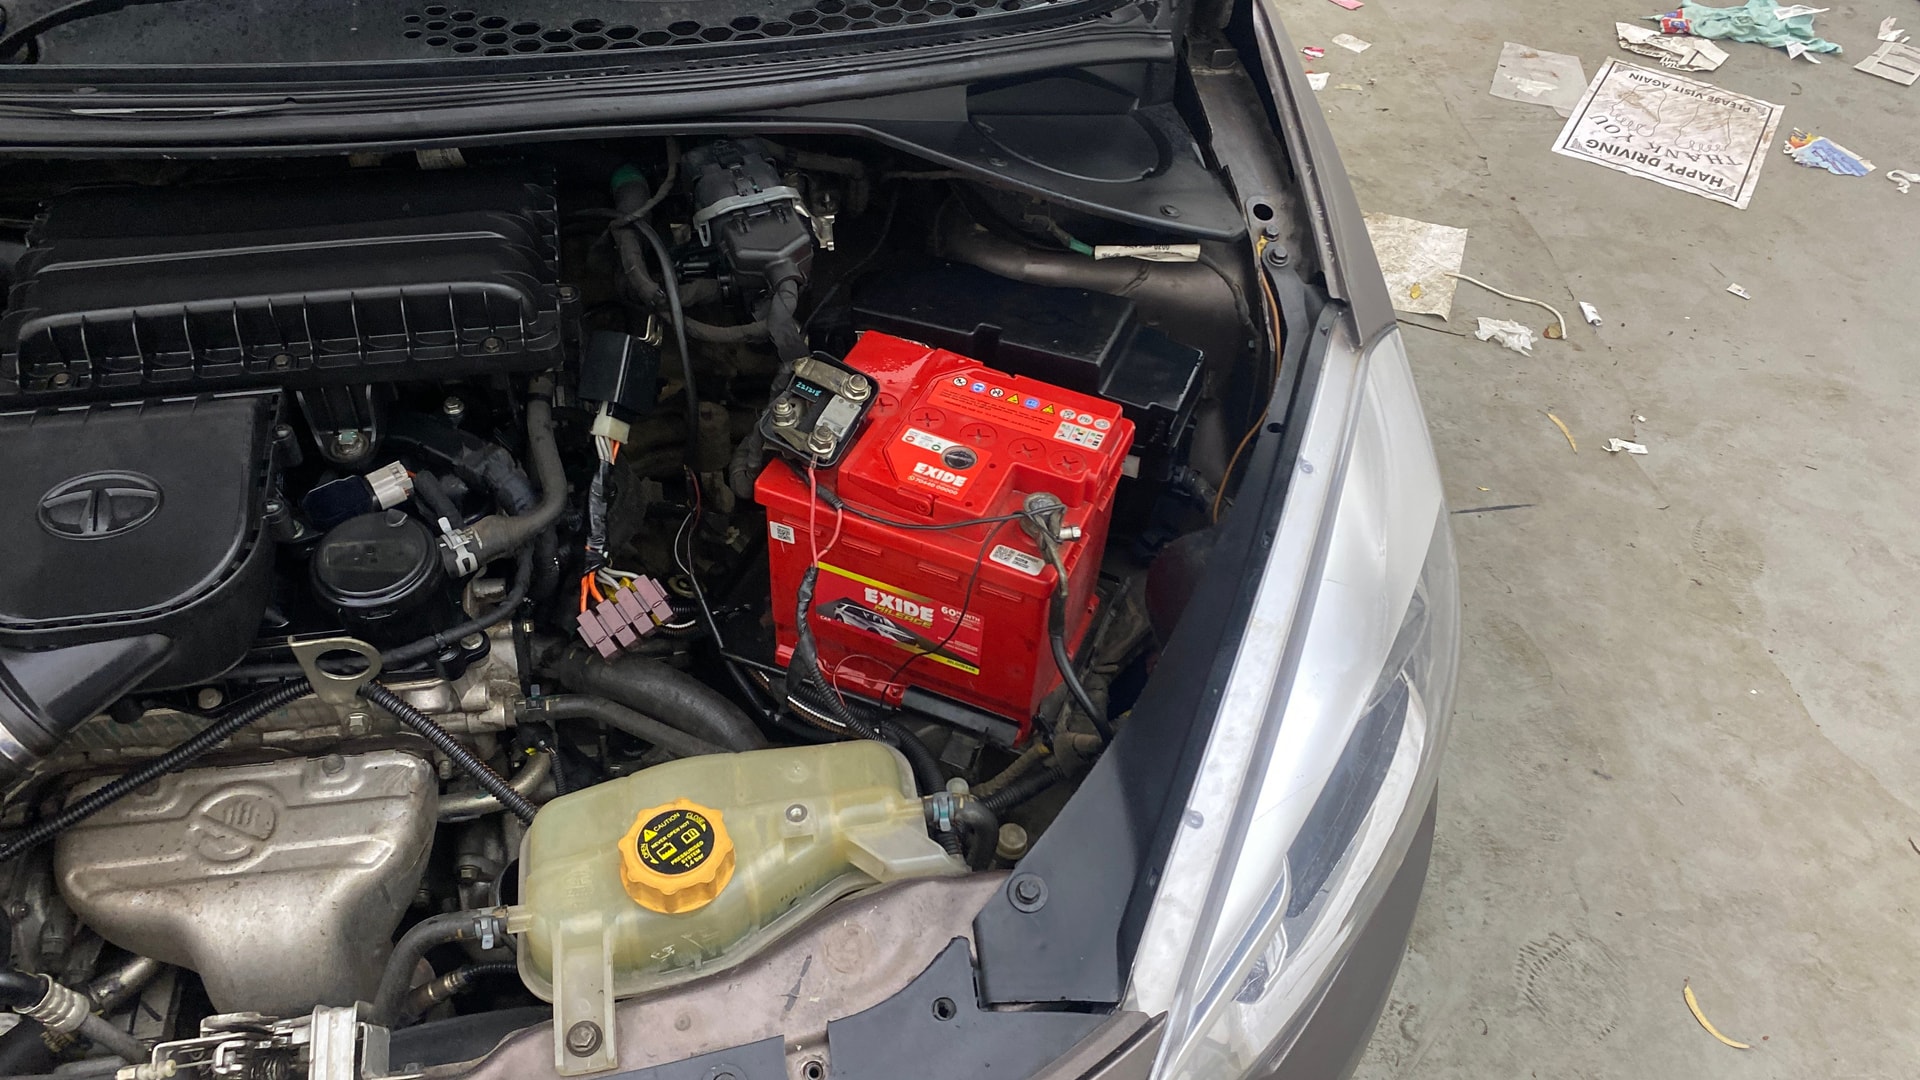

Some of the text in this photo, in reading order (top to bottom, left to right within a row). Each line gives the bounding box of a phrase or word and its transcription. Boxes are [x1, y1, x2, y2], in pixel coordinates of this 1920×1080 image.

[1628, 72, 1751, 113] PLEASE VISIT AGAIN
[1589, 113, 1743, 167] THANK YOU
[1585, 138, 1724, 188] HAPPY DRIVING
[913, 462, 968, 487] EXIDE
[864, 587, 935, 622] EXIDE
[874, 604, 933, 629] MILEAGE
[941, 606, 957, 617] 60
[653, 812, 680, 832] CAUTION
[686, 812, 705, 825] CLOSE
[650, 836, 667, 849] NEVER
[666, 827, 681, 838] OPEN
[680, 848, 701, 864] SYSTEM
